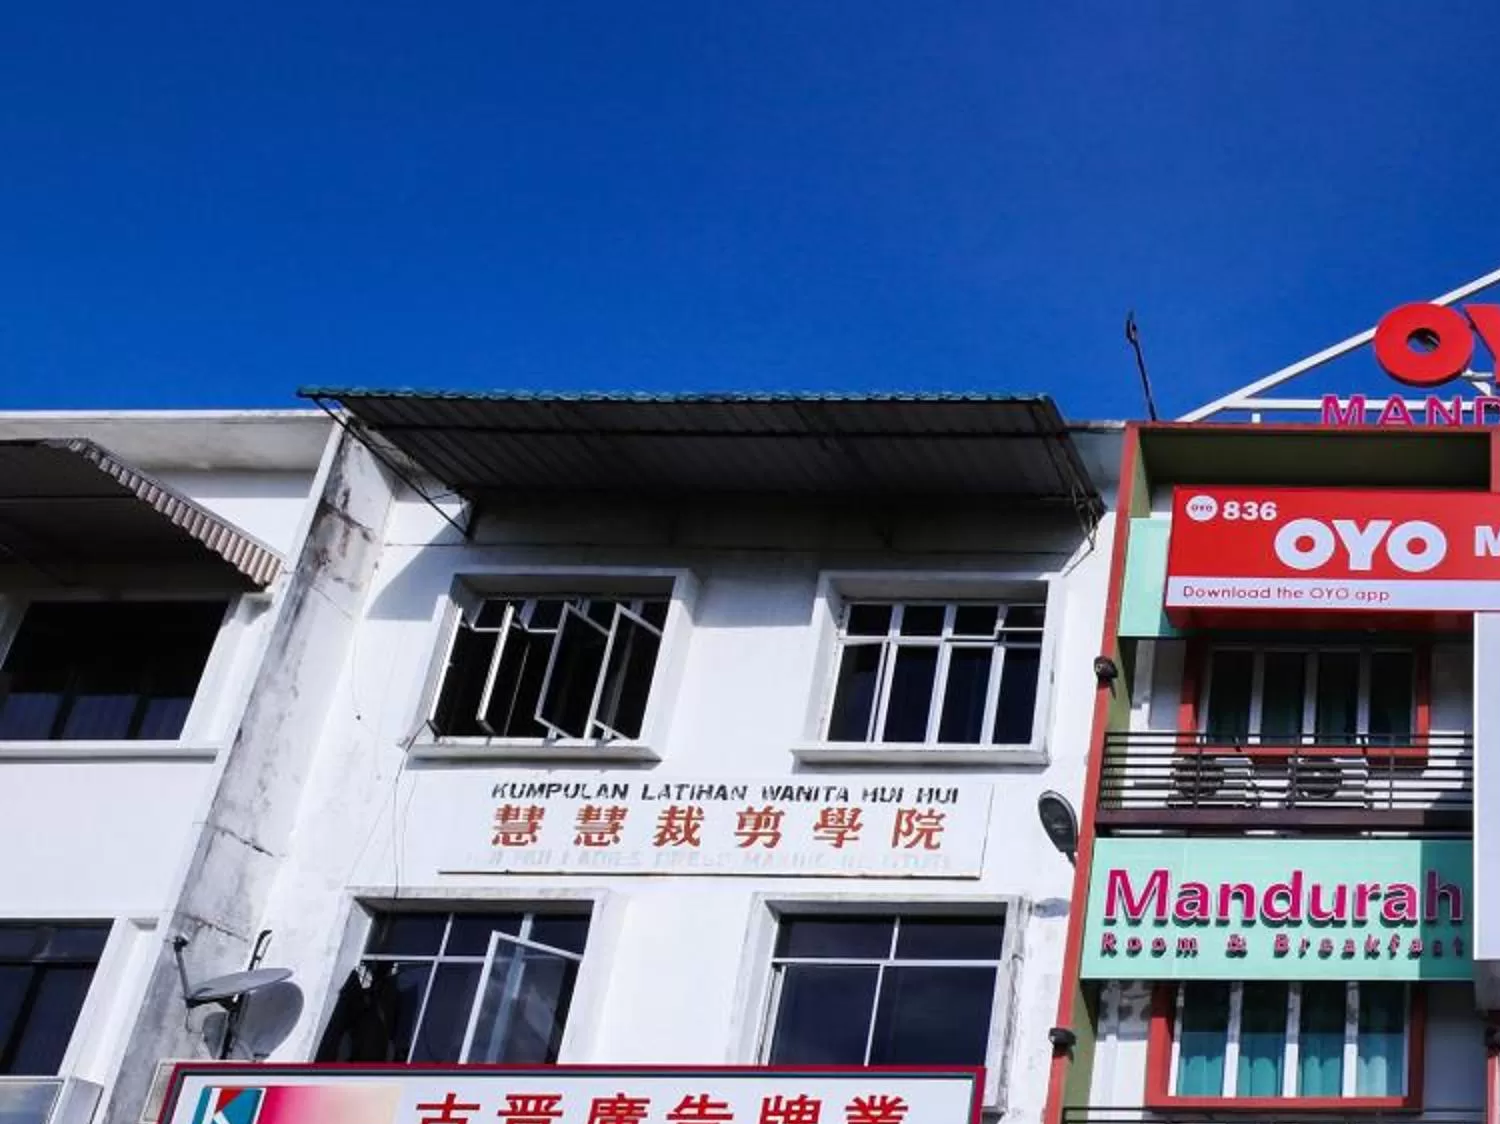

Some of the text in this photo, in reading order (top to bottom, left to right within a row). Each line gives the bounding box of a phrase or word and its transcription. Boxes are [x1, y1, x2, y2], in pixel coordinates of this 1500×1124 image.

[1222, 501, 1278, 521] 836
[1274, 518, 1448, 573] OYO
[1183, 585, 1390, 603] Download the OYO app
[491, 782, 629, 800] KUMPULAN
[641, 783, 749, 801] LATIHAN
[761, 784, 850, 803] WANITA
[915, 786, 959, 804] HUI
[491, 804, 946, 850] 慧慧裁剪學院
[1104, 867, 1465, 924] Mandurah
[1102, 933, 1465, 958] Room & Breakfast
